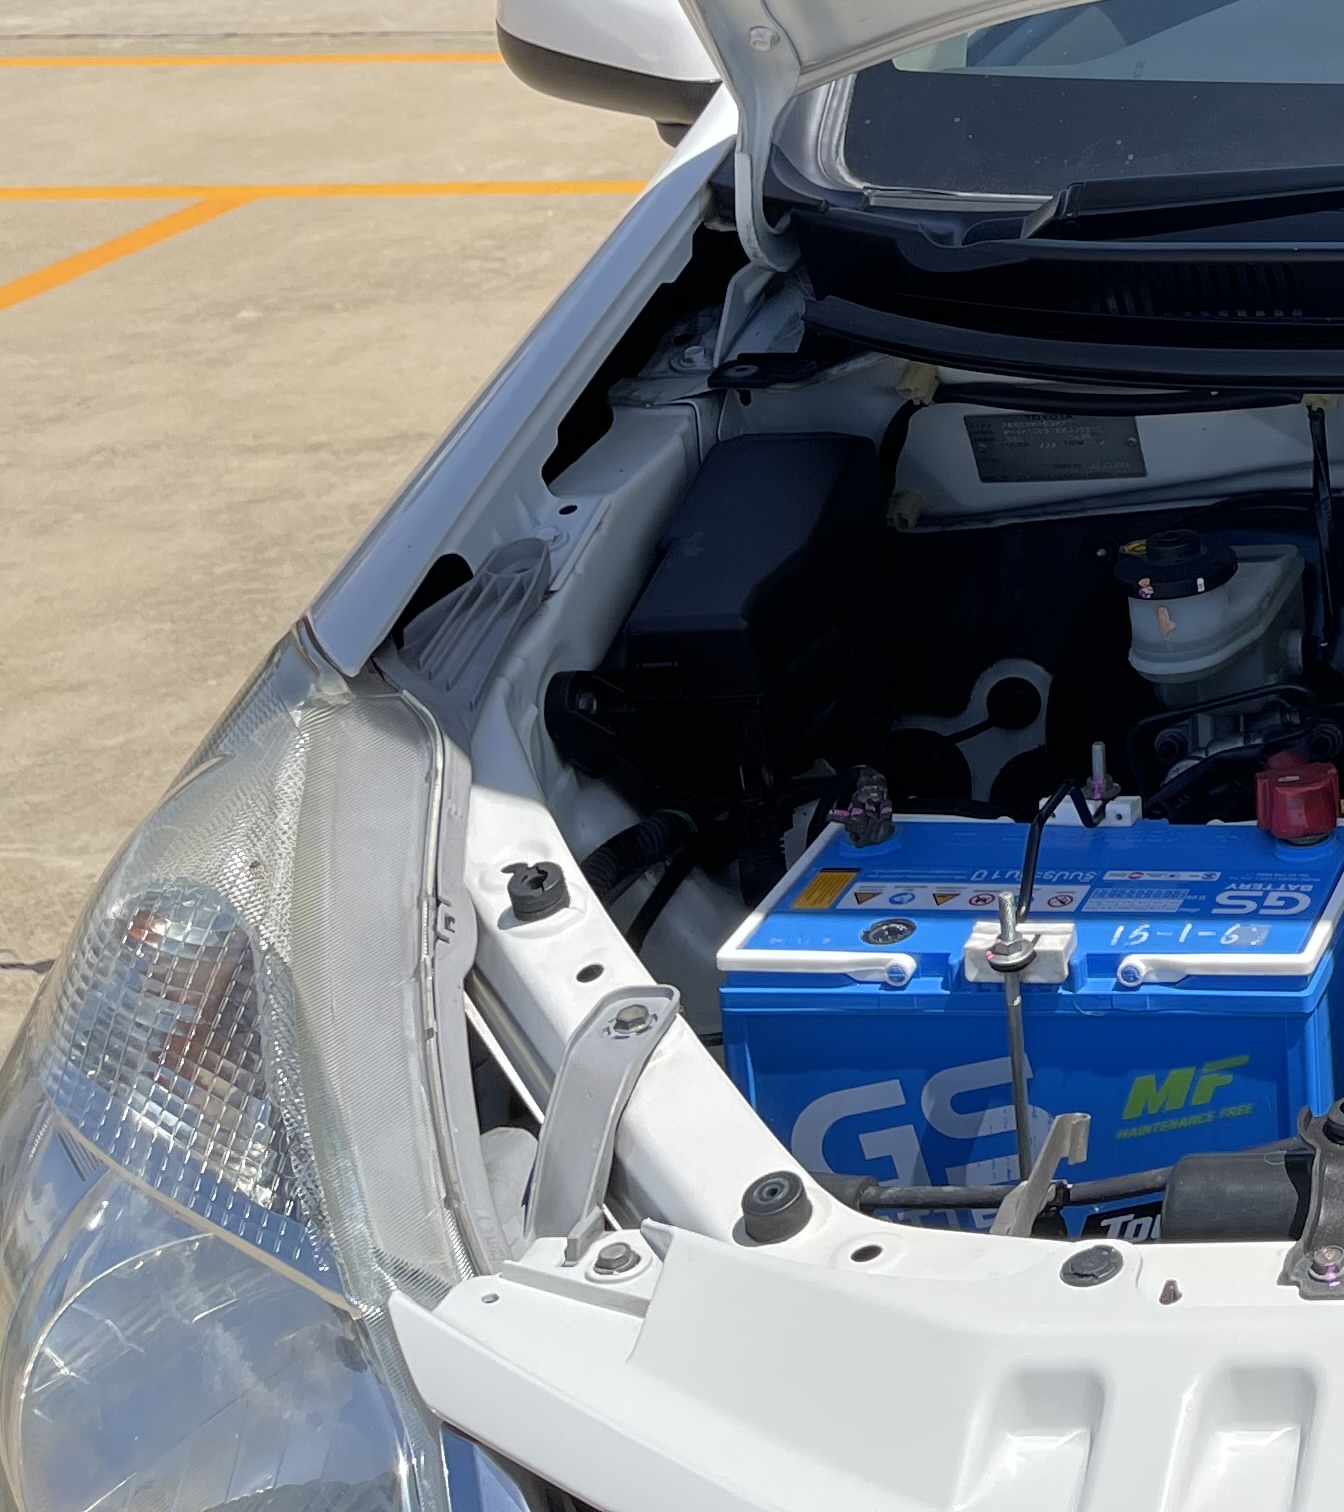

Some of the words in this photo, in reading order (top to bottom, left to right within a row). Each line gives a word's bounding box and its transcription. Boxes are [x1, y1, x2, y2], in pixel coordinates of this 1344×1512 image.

[1211, 890, 1312, 915] GS
[1224, 882, 1314, 893] BATTERY
[1122, 1055, 1249, 1121] MF
[791, 1054, 1057, 1187] GS
[1115, 1111, 1217, 1140] MAINTENANCE
[1218, 1103, 1254, 1121] FREE
